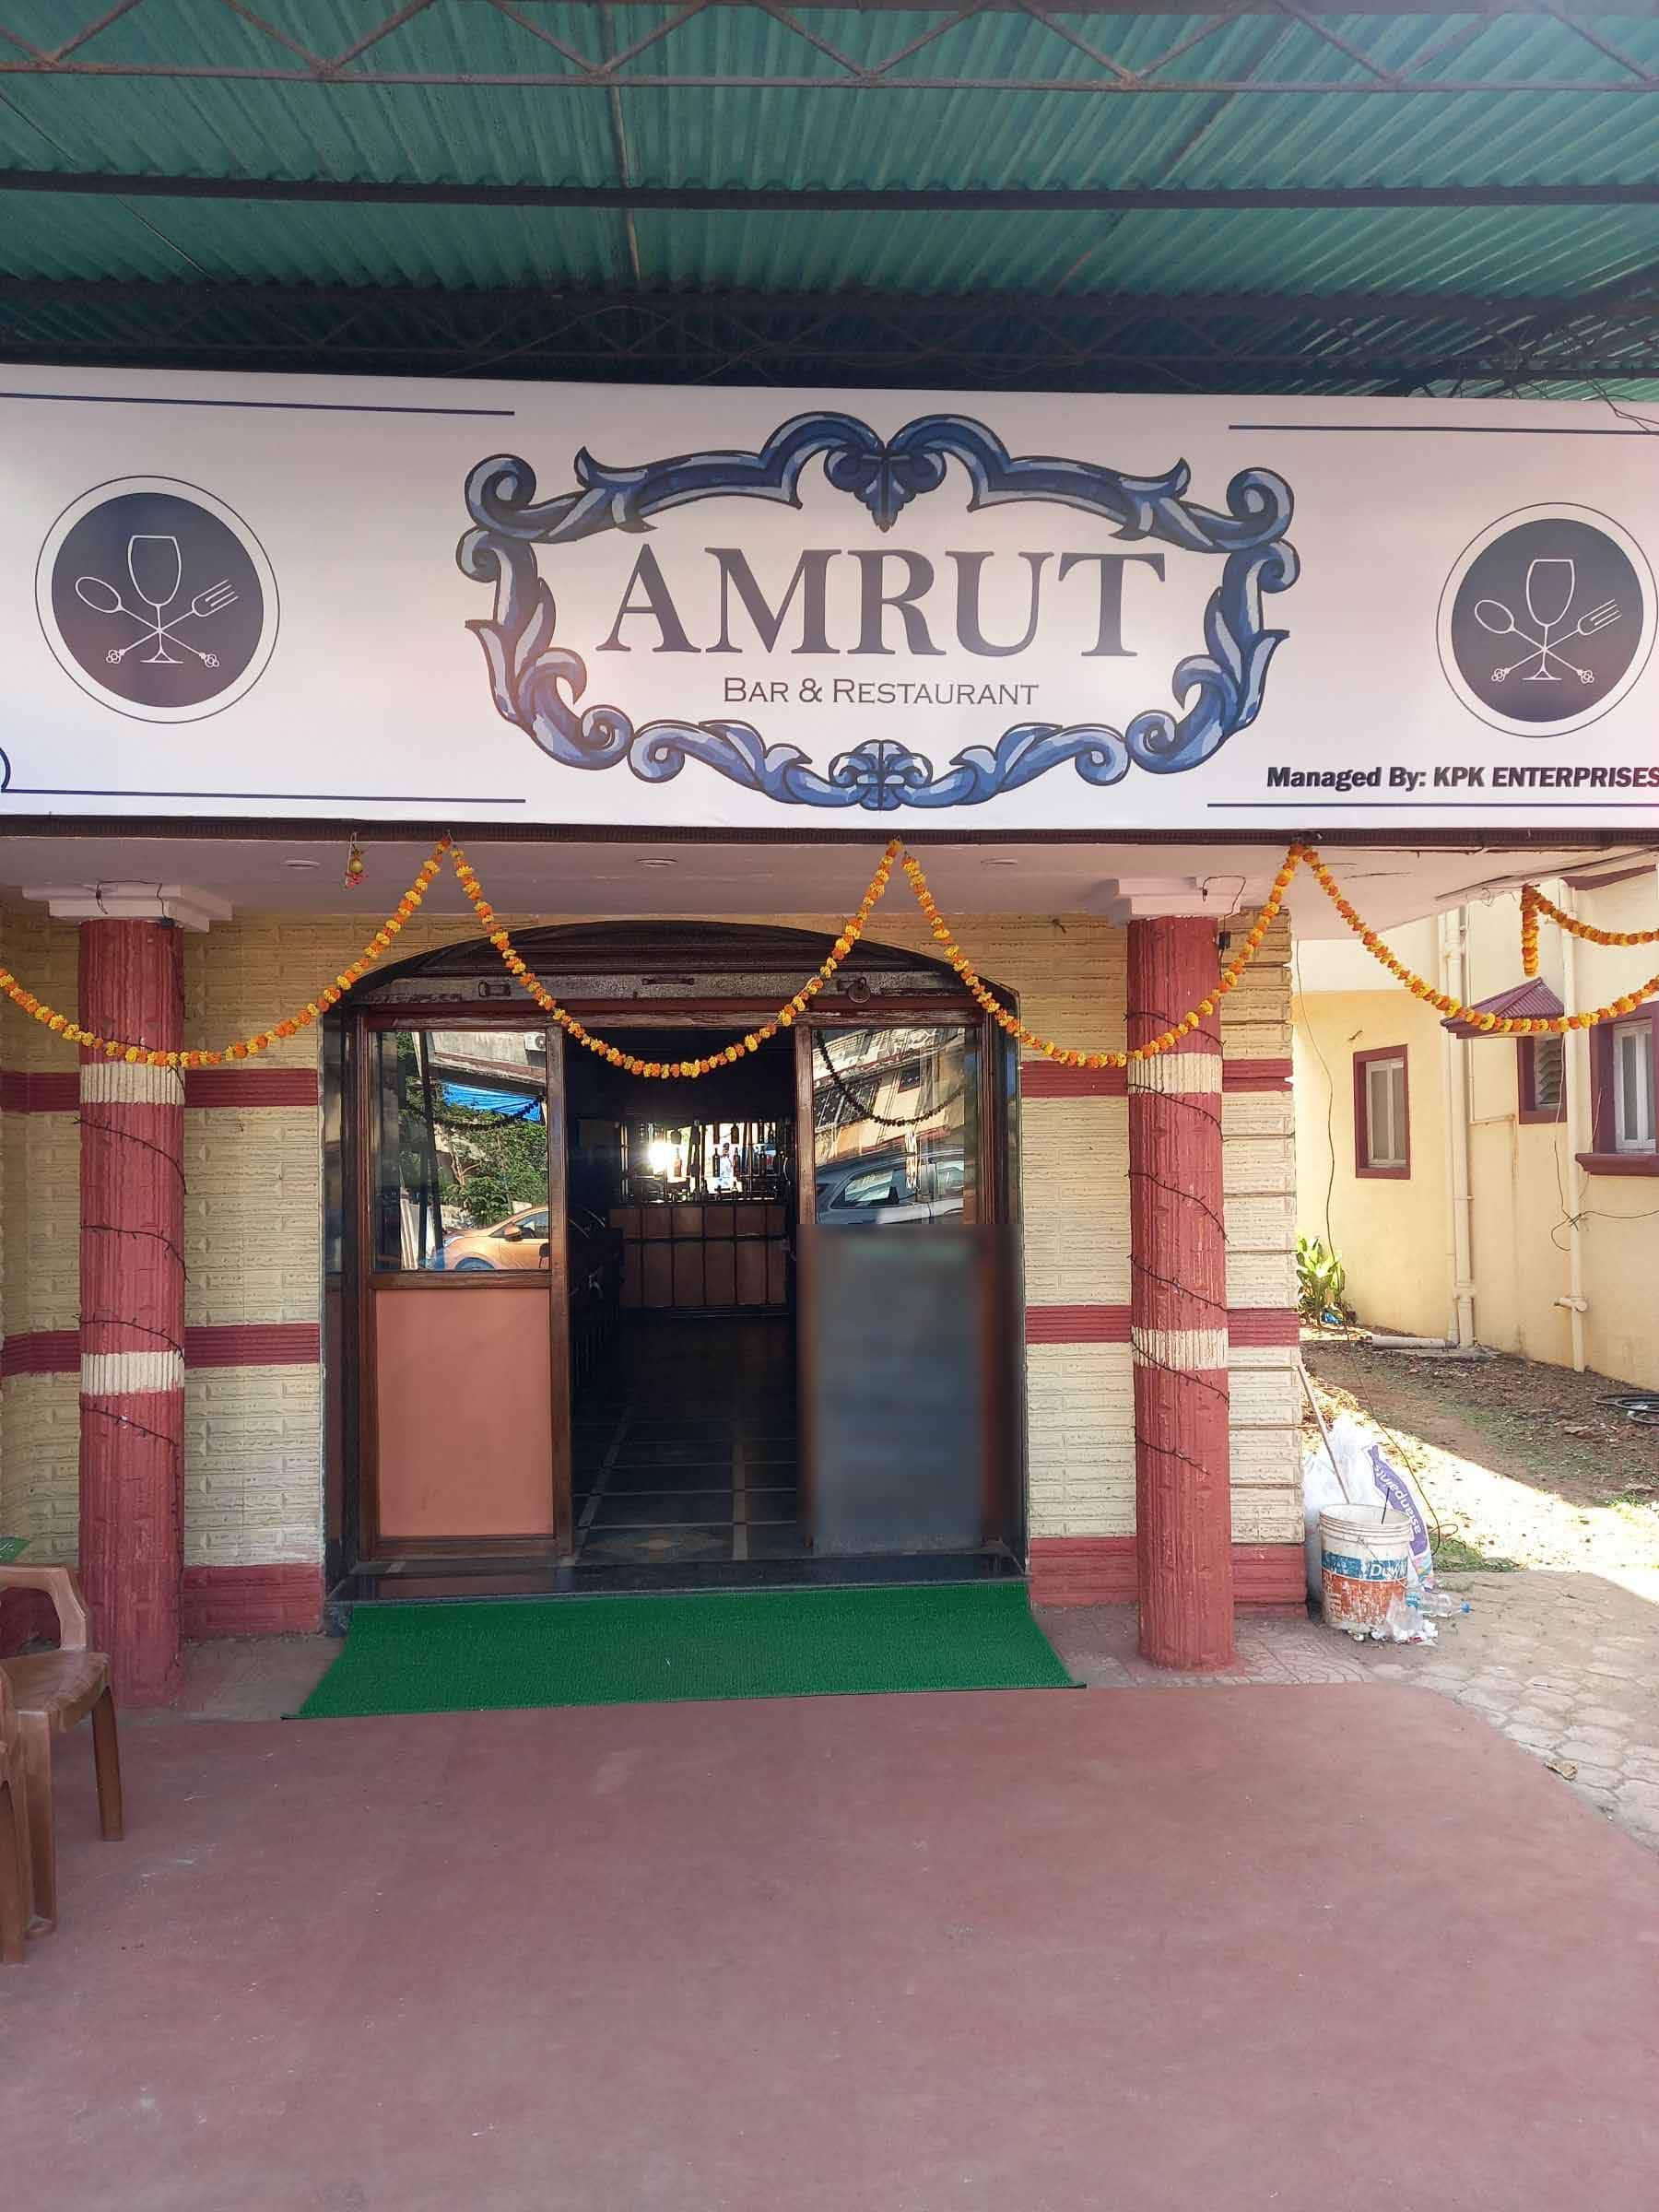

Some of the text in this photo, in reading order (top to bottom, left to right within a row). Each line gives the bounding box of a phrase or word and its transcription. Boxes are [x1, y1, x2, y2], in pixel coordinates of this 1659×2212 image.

[595, 543, 1165, 657] AMRUT
[798, 677, 823, 703] &
[1266, 766, 1659, 792] Managed By: KPK ENTERPRISES
